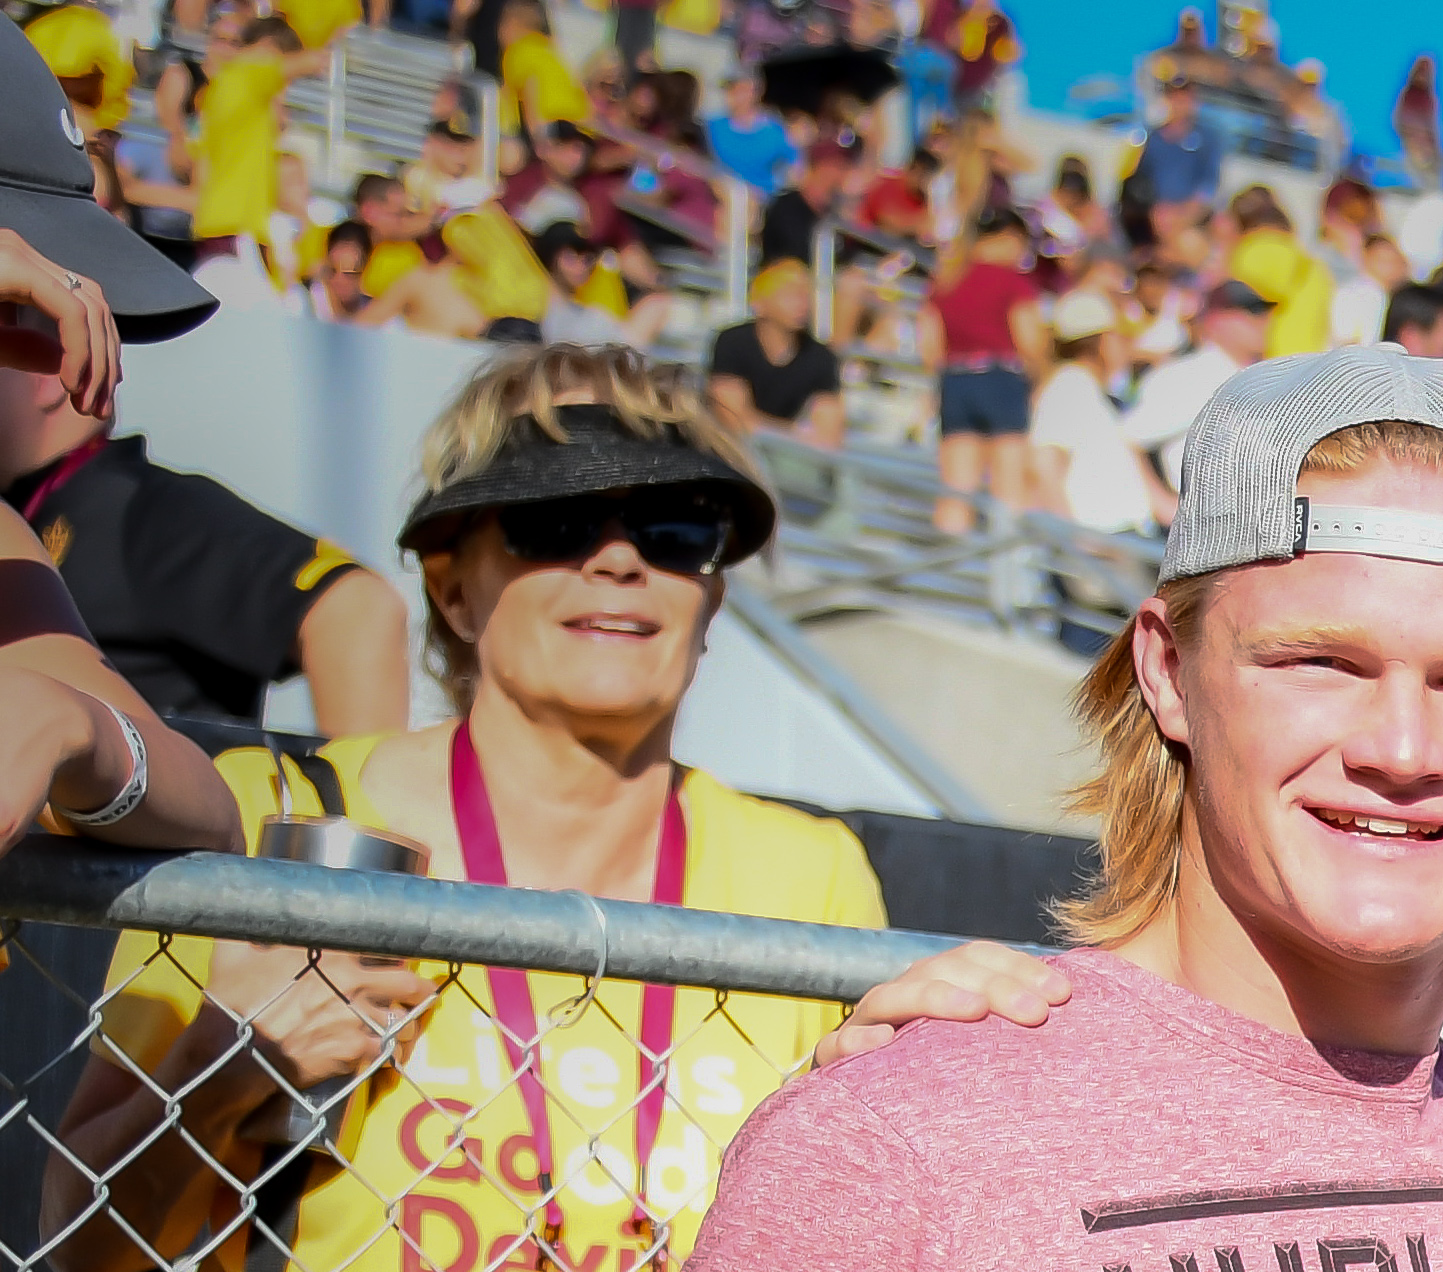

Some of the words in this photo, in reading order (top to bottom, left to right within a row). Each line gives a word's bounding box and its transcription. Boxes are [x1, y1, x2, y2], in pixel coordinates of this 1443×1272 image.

[1295, 504, 1304, 543] RVCA
[404, 1009, 620, 1109] Lie
[398, 1097, 709, 1214] Good
